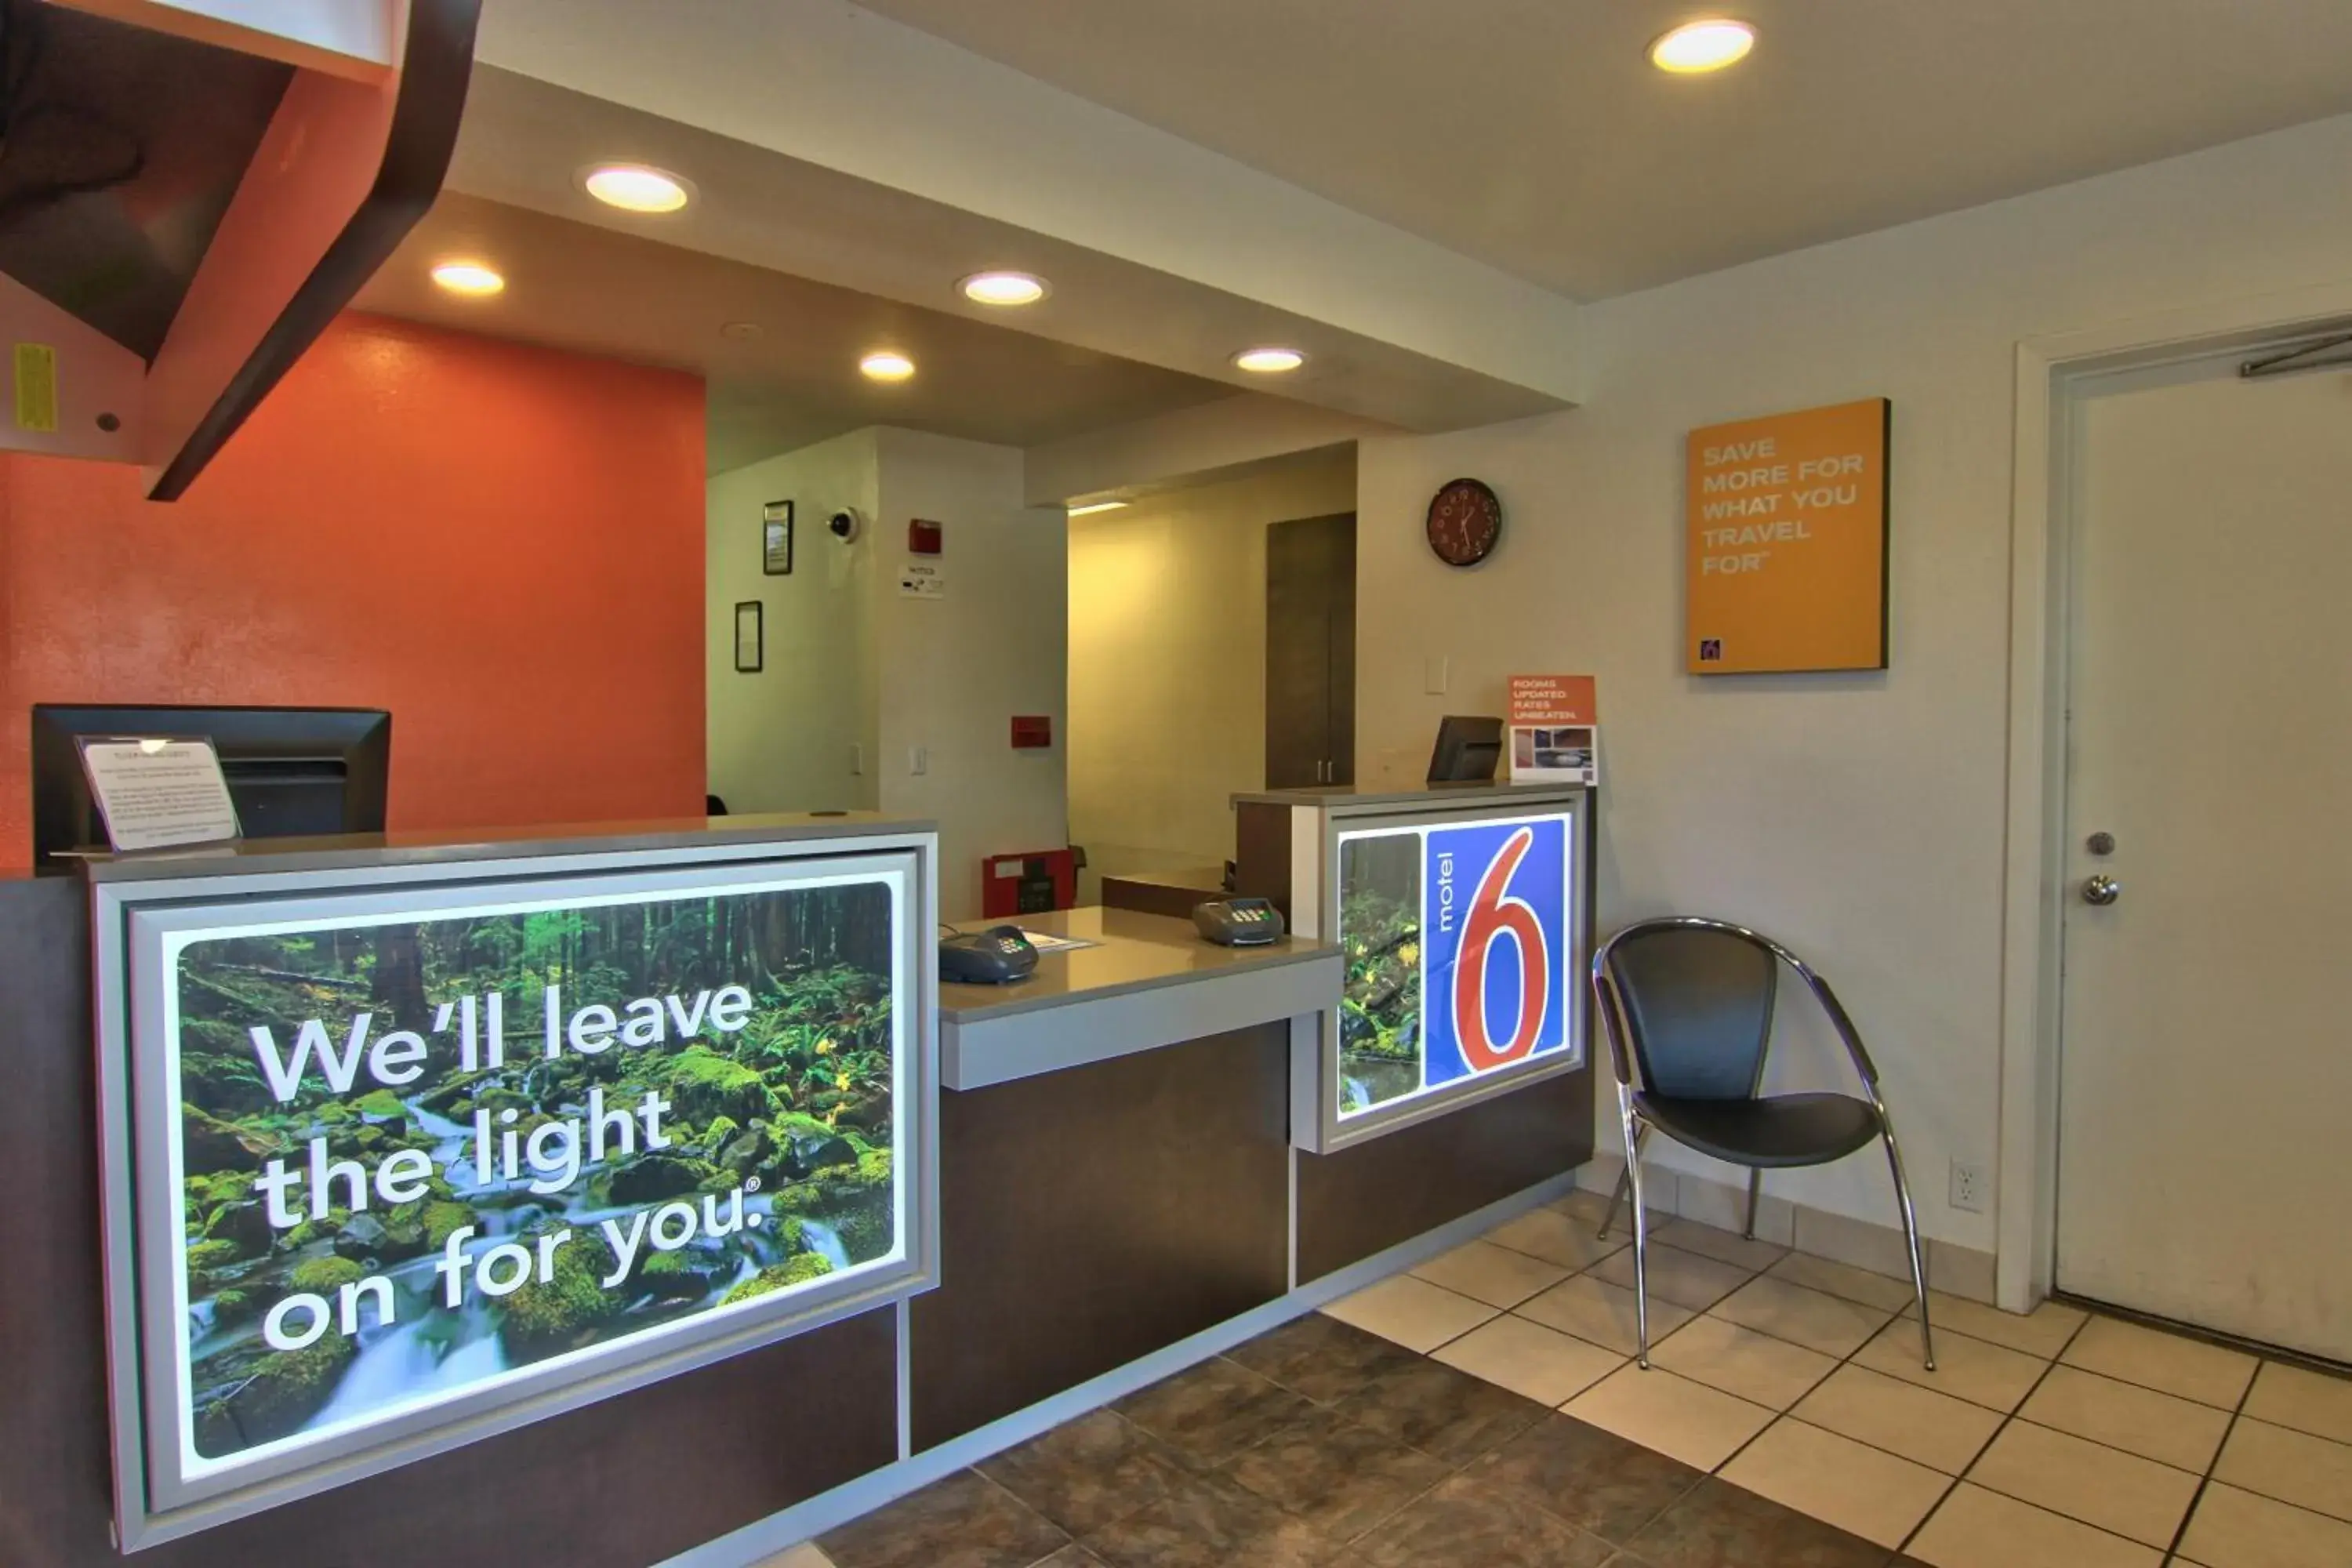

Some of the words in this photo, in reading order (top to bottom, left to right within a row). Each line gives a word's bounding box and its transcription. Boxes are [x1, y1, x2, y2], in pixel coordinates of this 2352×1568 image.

[1703, 437, 1777, 467] SAVE
[1703, 465, 1789, 494] MORE
[1798, 454, 1864, 481] FOR
[1702, 493, 1782, 521] WHAT
[1791, 485, 1857, 510] YOU
[1701, 521, 1812, 550] TRAVEL
[1512, 679, 1557, 689] ROOMS
[1513, 700, 1552, 710] RATES
[1436, 851, 1454, 933] motel
[1450, 826, 1550, 1075] 6
[544, 985, 753, 1060] leave
[255, 1138, 434, 1229] the
[474, 1087, 673, 1196] light
[262, 1275, 395, 1352] on
[436, 1225, 573, 1309] for
